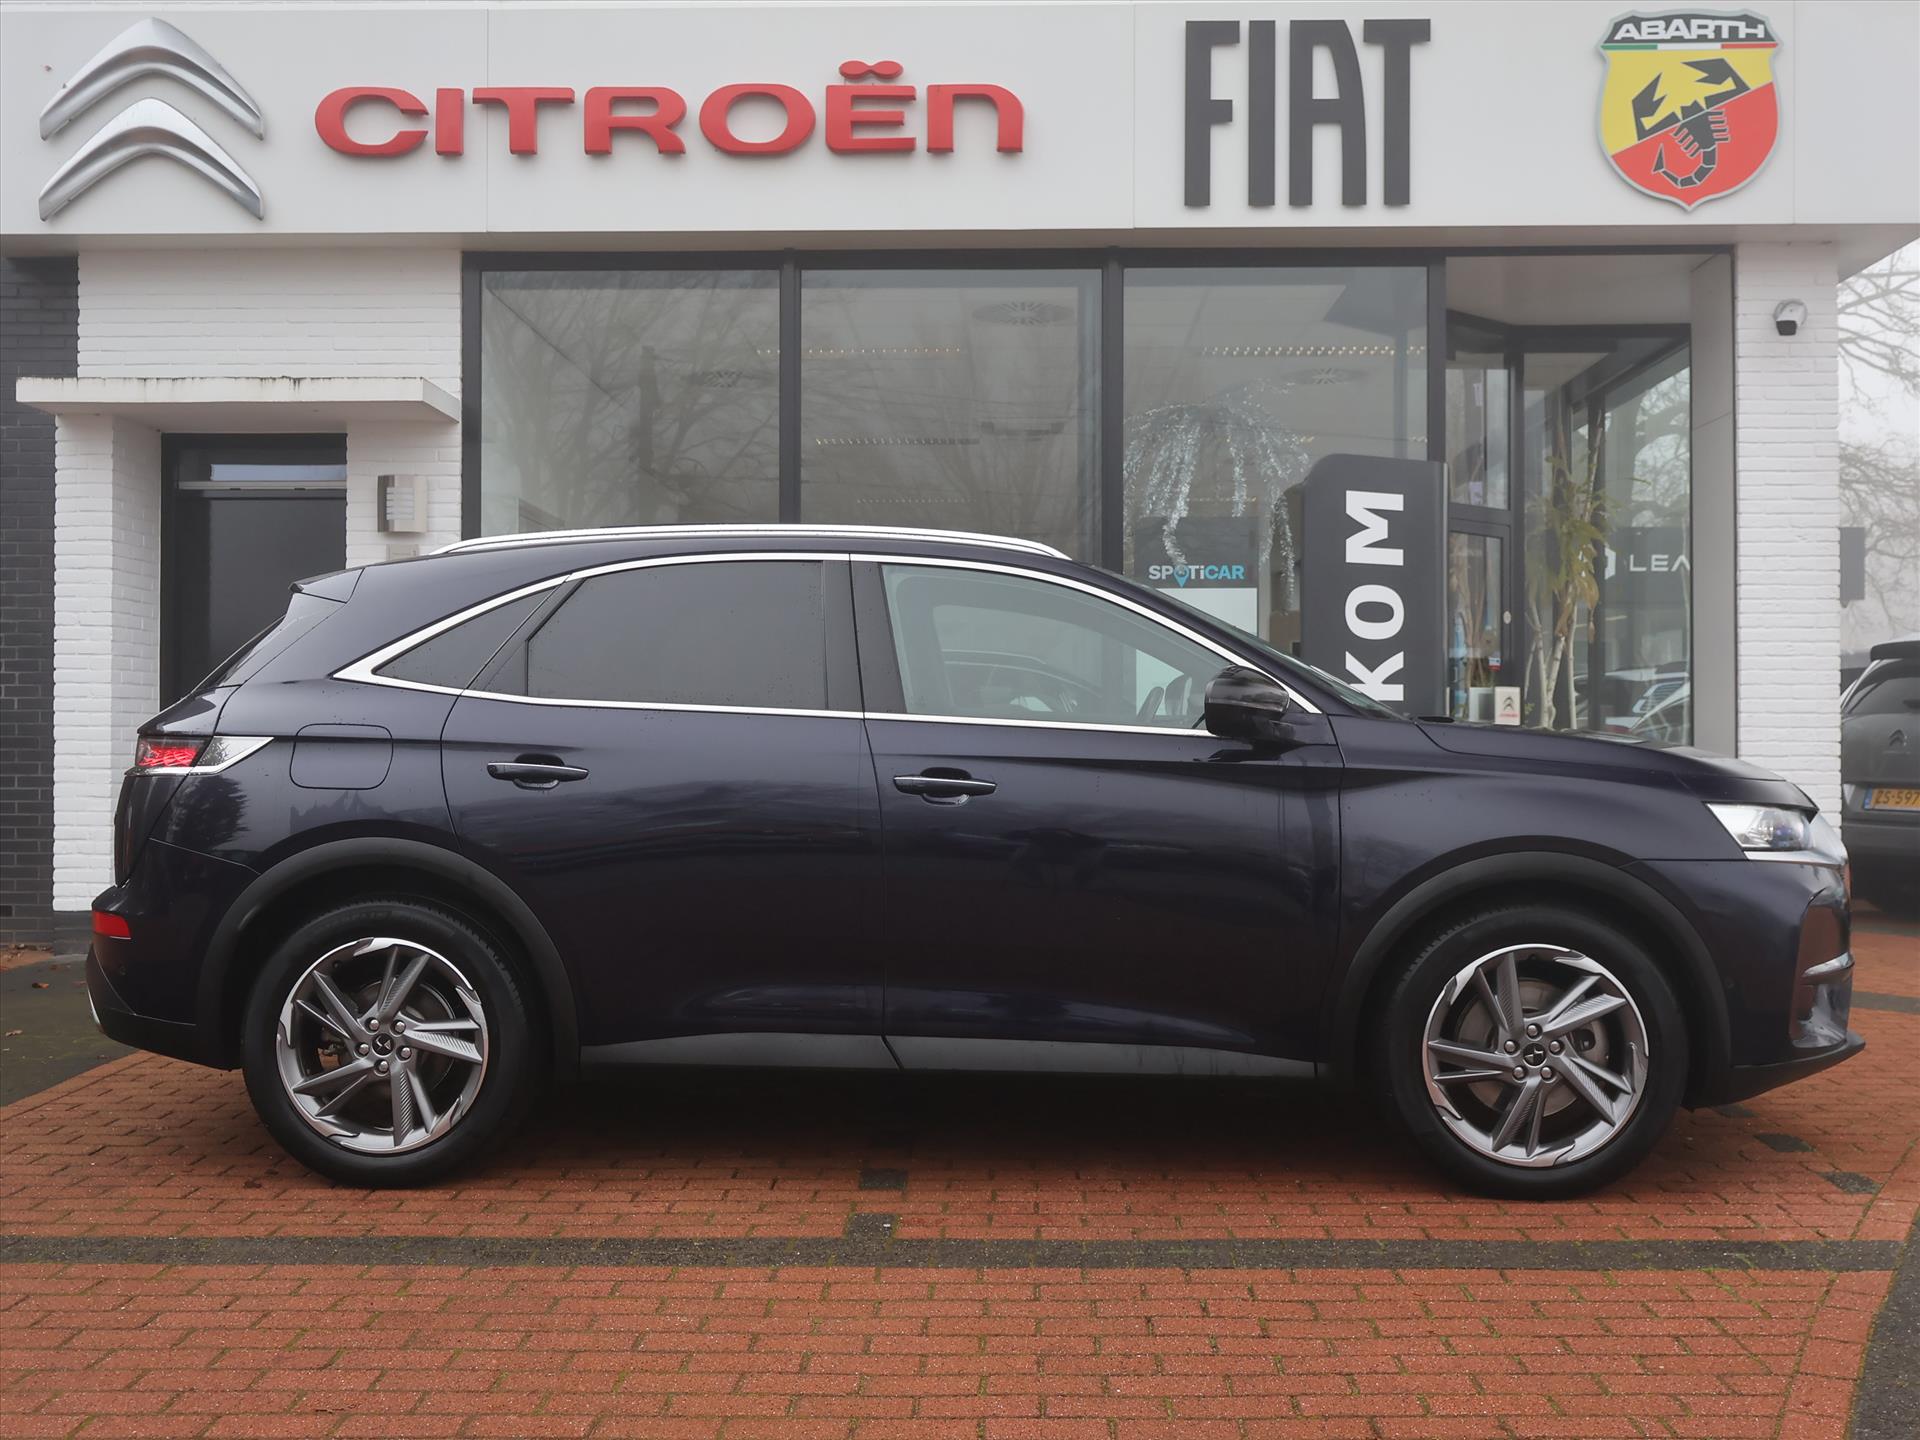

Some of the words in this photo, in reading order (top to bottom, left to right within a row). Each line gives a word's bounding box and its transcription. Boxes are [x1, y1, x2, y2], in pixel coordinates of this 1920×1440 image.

[1613, 18, 1765, 40] ABARTH
[315, 60, 1024, 158] CITROËN
[1184, 19, 1431, 208] FIAT
[1345, 490, 1404, 702] KOM
